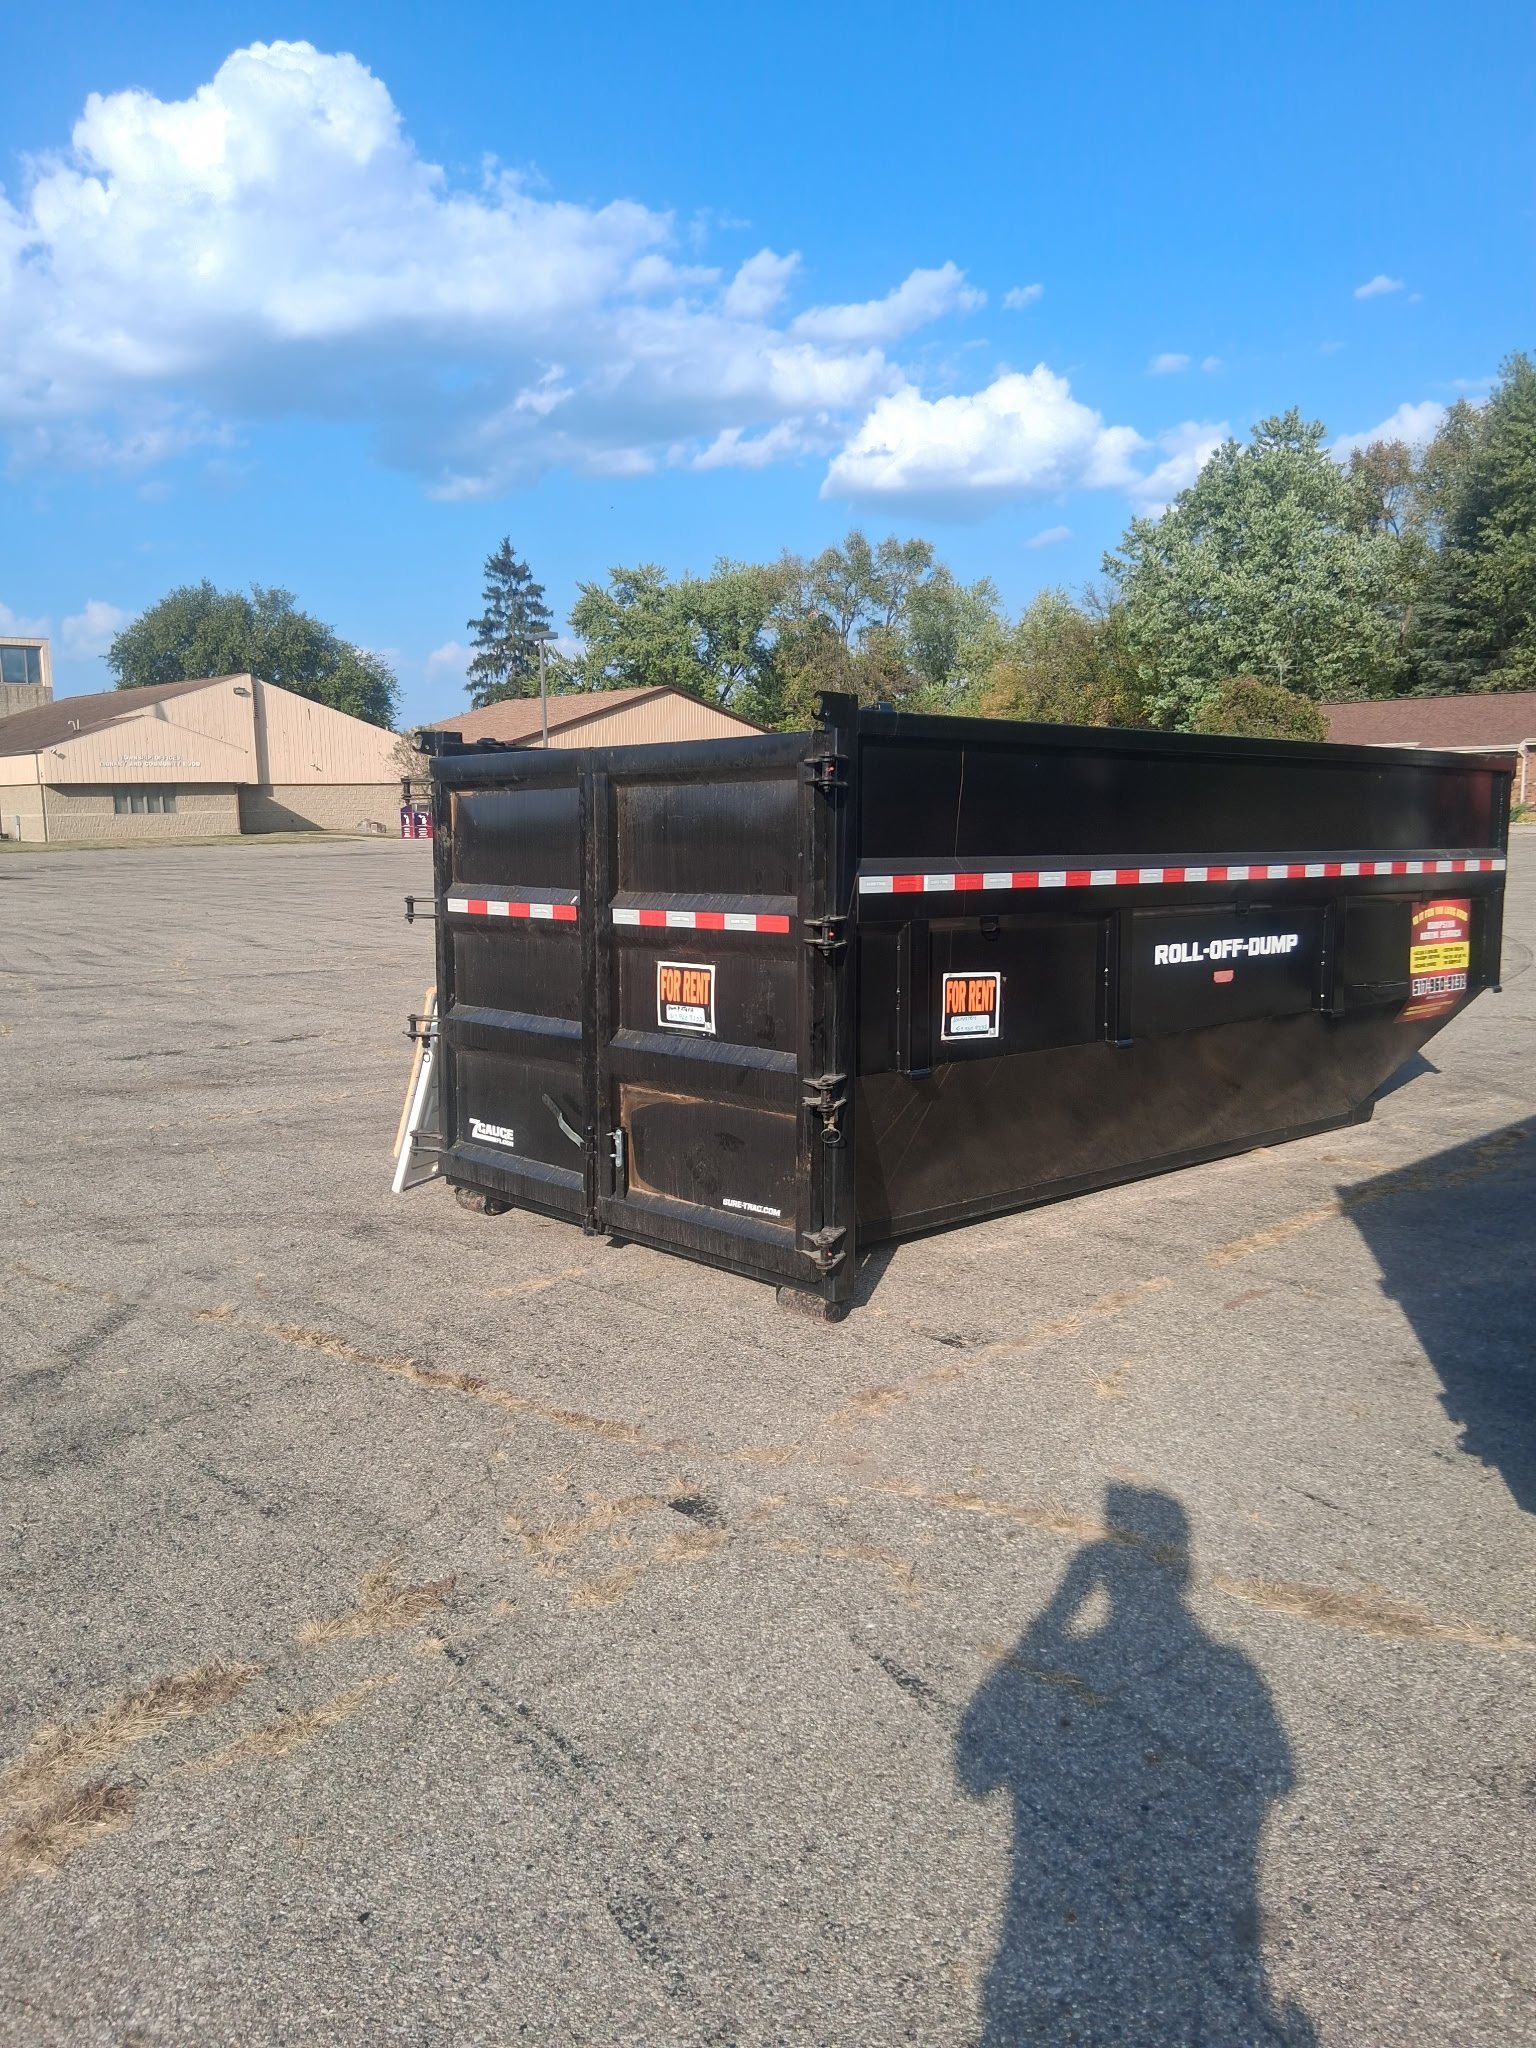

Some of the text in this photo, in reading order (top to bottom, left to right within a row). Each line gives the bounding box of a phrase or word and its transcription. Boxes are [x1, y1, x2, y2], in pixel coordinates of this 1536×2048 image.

[1154, 934, 1299, 965] ROLL-OFF-DUMP
[660, 968, 711, 1005] FOR RENT
[946, 979, 996, 1013] FOR RENT
[722, 1198, 781, 1217] SURE-TRAC.COM
